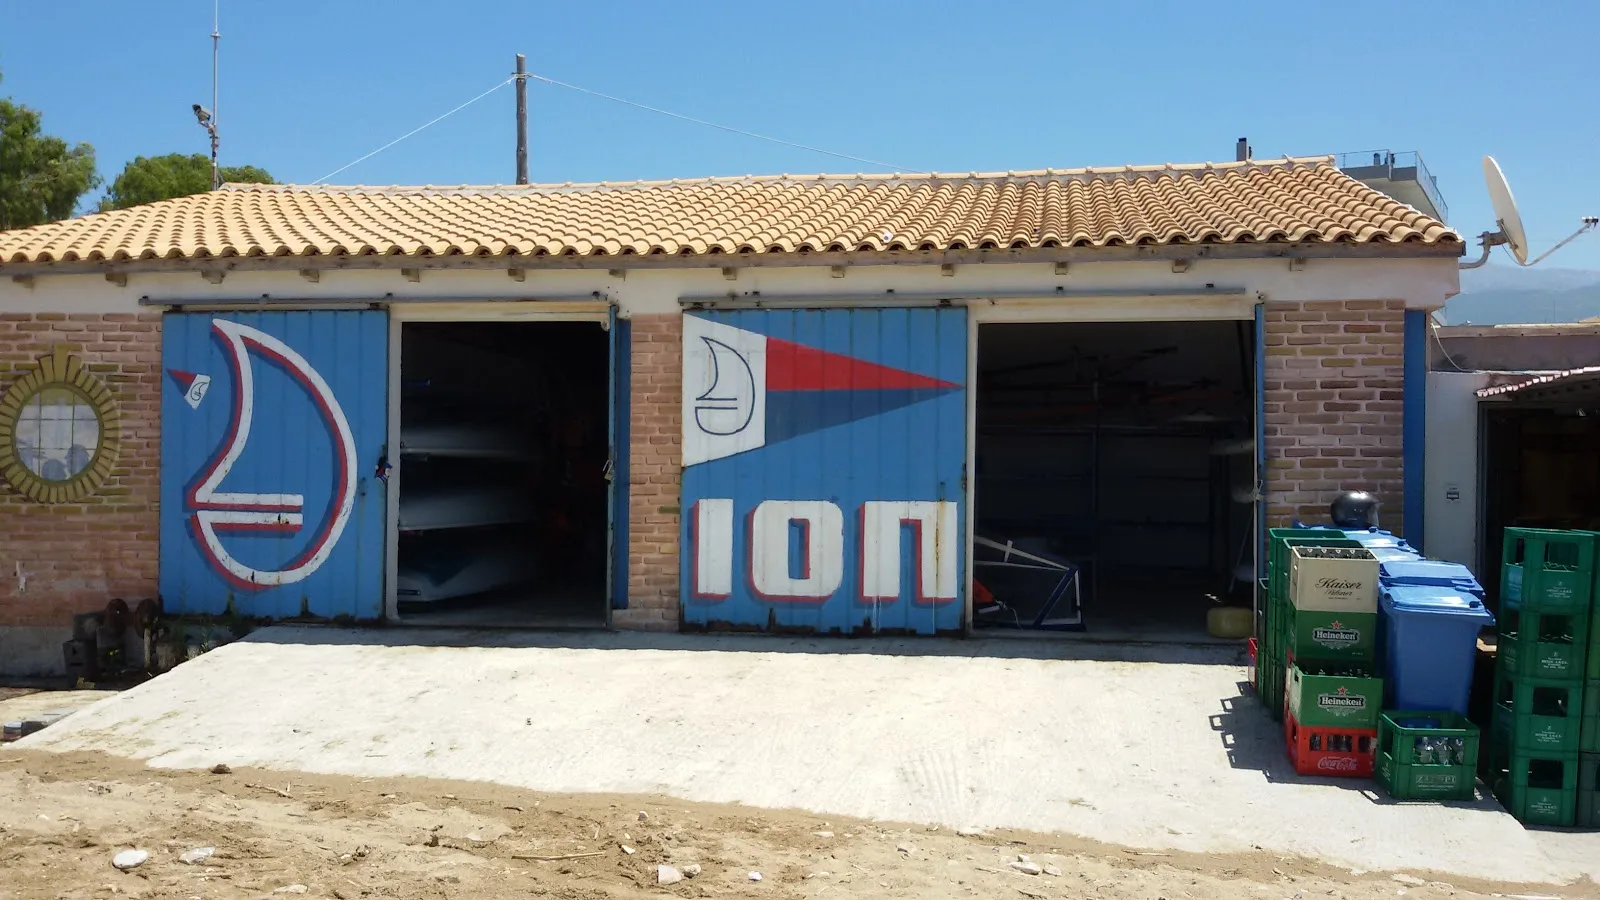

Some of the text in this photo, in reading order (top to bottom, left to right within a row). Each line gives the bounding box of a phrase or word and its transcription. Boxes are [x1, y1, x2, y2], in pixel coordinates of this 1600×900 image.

[1315, 577, 1363, 589] Kaiser
[1316, 630, 1356, 640] Heineken
[1321, 696, 1362, 706] Heineken
